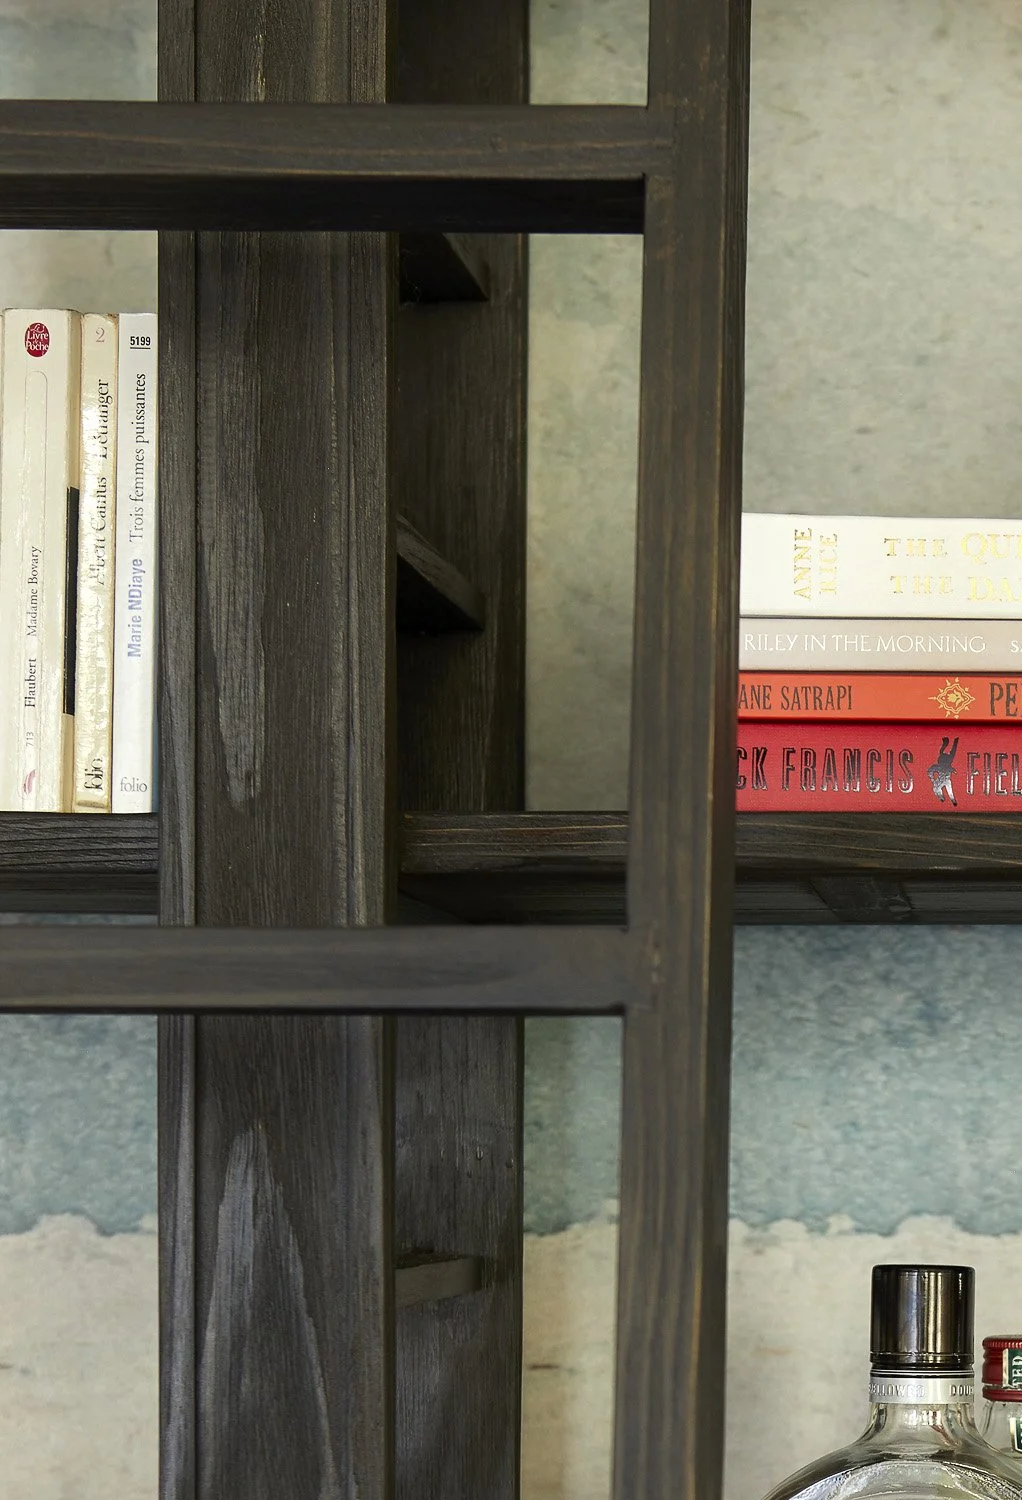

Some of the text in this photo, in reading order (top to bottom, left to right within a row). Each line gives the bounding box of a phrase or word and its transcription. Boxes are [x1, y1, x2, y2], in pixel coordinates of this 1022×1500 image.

[27, 330, 49, 340] Livre
[95, 327, 105, 343] 2
[130, 336, 151, 346] 5199
[25, 341, 49, 351] Poche
[129, 373, 149, 543] Trois femmes puissantes
[884, 537, 948, 557] THE
[793, 527, 812, 600] ANNE
[819, 533, 838, 595] RICE
[26, 546, 42, 637] Madame Bovary
[890, 575, 953, 595] THE
[127, 558, 146, 658] Marie NDiaye
[744, 633, 986, 653] RILEY IN THE MORNING
[24, 658, 37, 708] Flaubert
[781, 684, 853, 711] SATRAPI
[26, 731, 34, 747] 713
[781, 747, 914, 794] FRANCIS
[120, 776, 148, 793] folio
